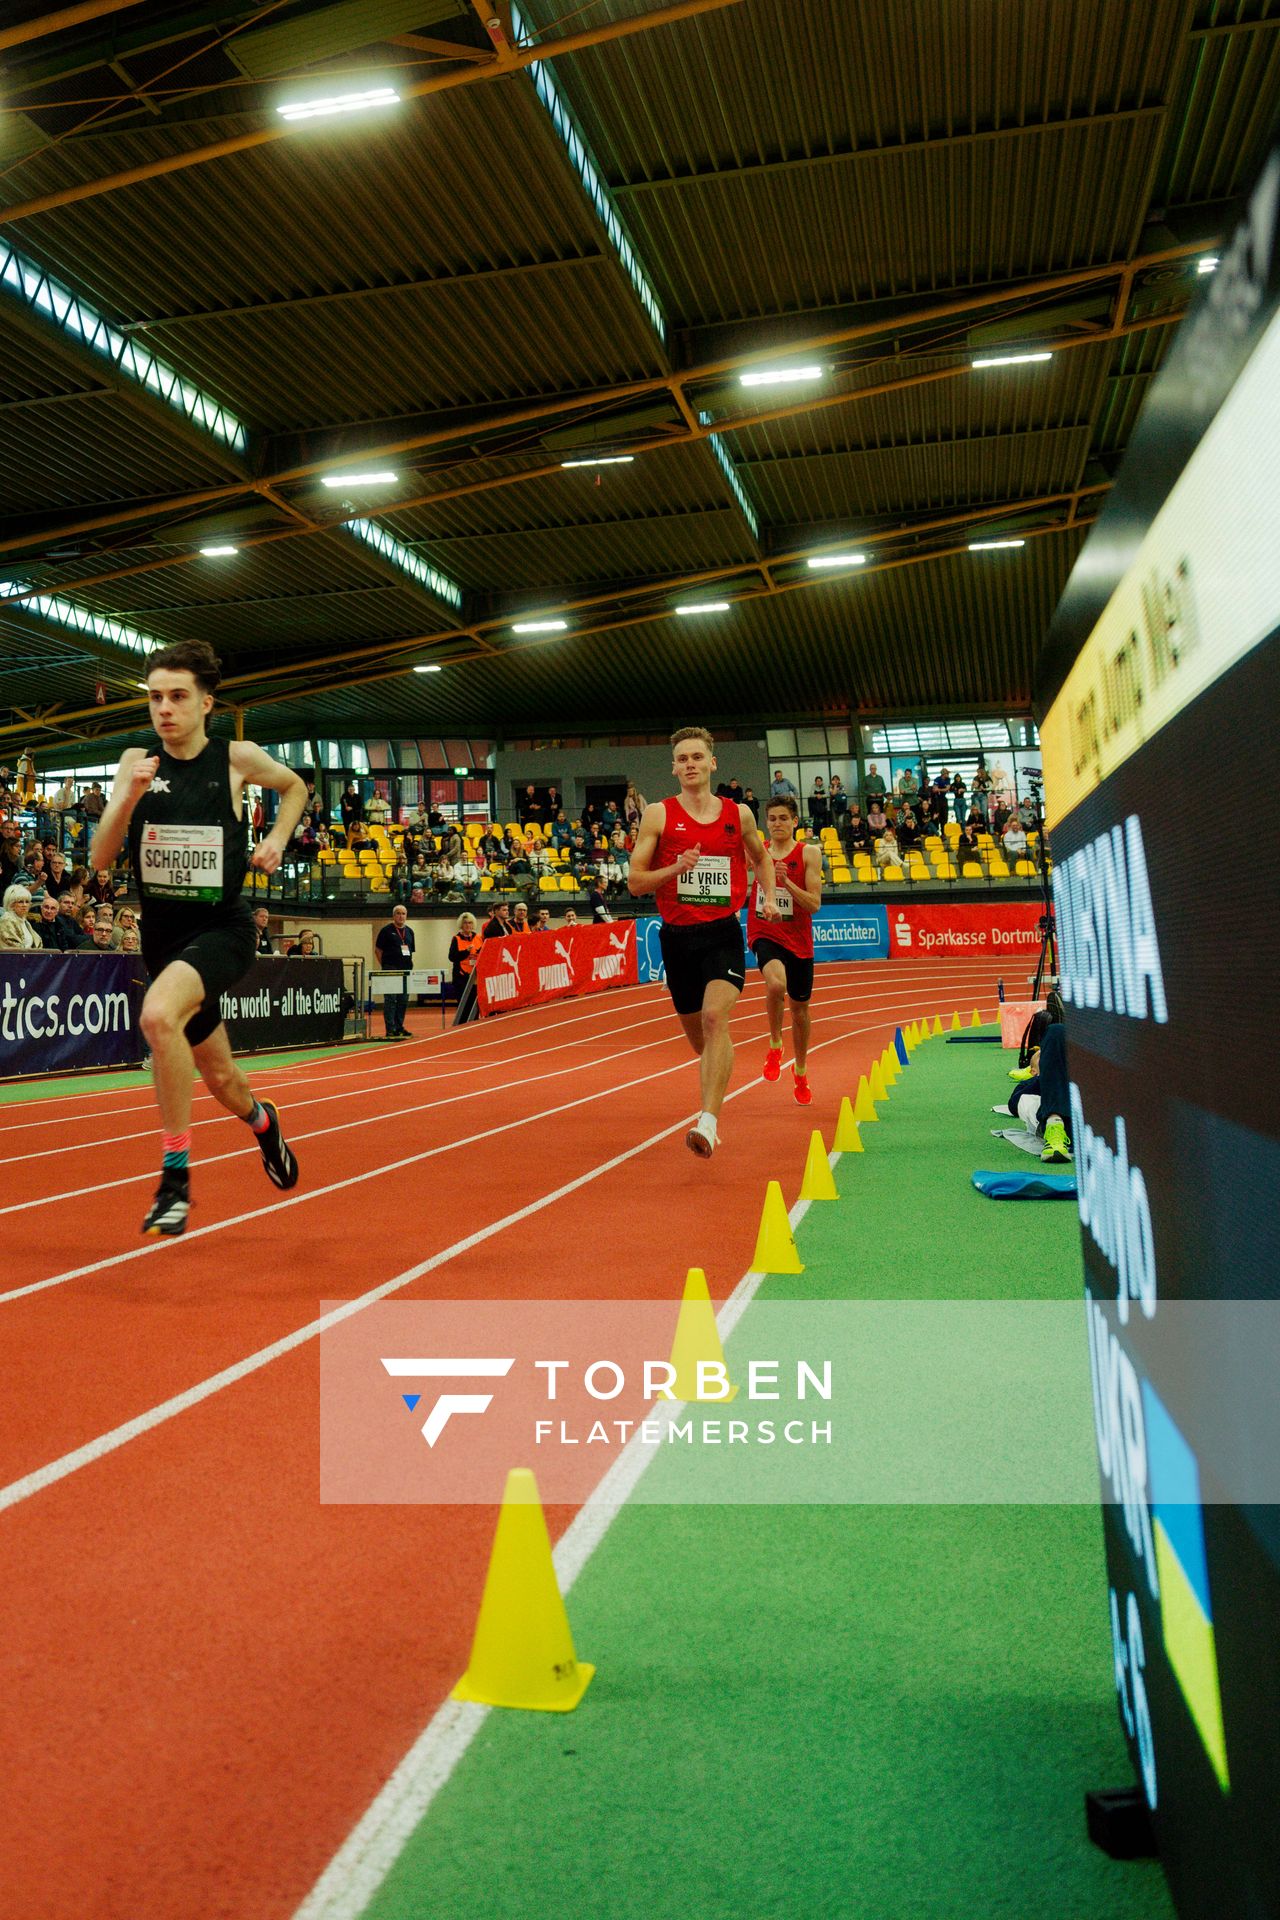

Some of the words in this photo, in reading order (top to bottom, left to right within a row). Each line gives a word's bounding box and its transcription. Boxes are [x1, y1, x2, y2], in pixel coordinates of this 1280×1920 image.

[97, 686, 105, 702] A
[1100, 629, 1145, 746] Jump
[181, 828, 204, 836] Meeting
[145, 845, 217, 870] SCHRÖDER
[168, 870, 193, 885] 164
[681, 872, 694, 884] DE
[698, 872, 728, 885] VRIES
[149, 886, 188, 897] DORTMUND
[699, 886, 710, 895] 35
[813, 922, 877, 942] Nachrichten
[918, 928, 987, 950] Sparkasse
[992, 928, 1058, 945] Dortmu
[485, 972, 517, 1004] PUMA
[538, 963, 570, 992] PUMA
[0, 978, 130, 1041] tics.com
[219, 990, 238, 1020] the
[240, 988, 271, 1019] world
[281, 987, 294, 1017] all
[296, 987, 312, 1015] the
[313, 987, 341, 1014] Game!
[1084, 1287, 1158, 1600] UKR
